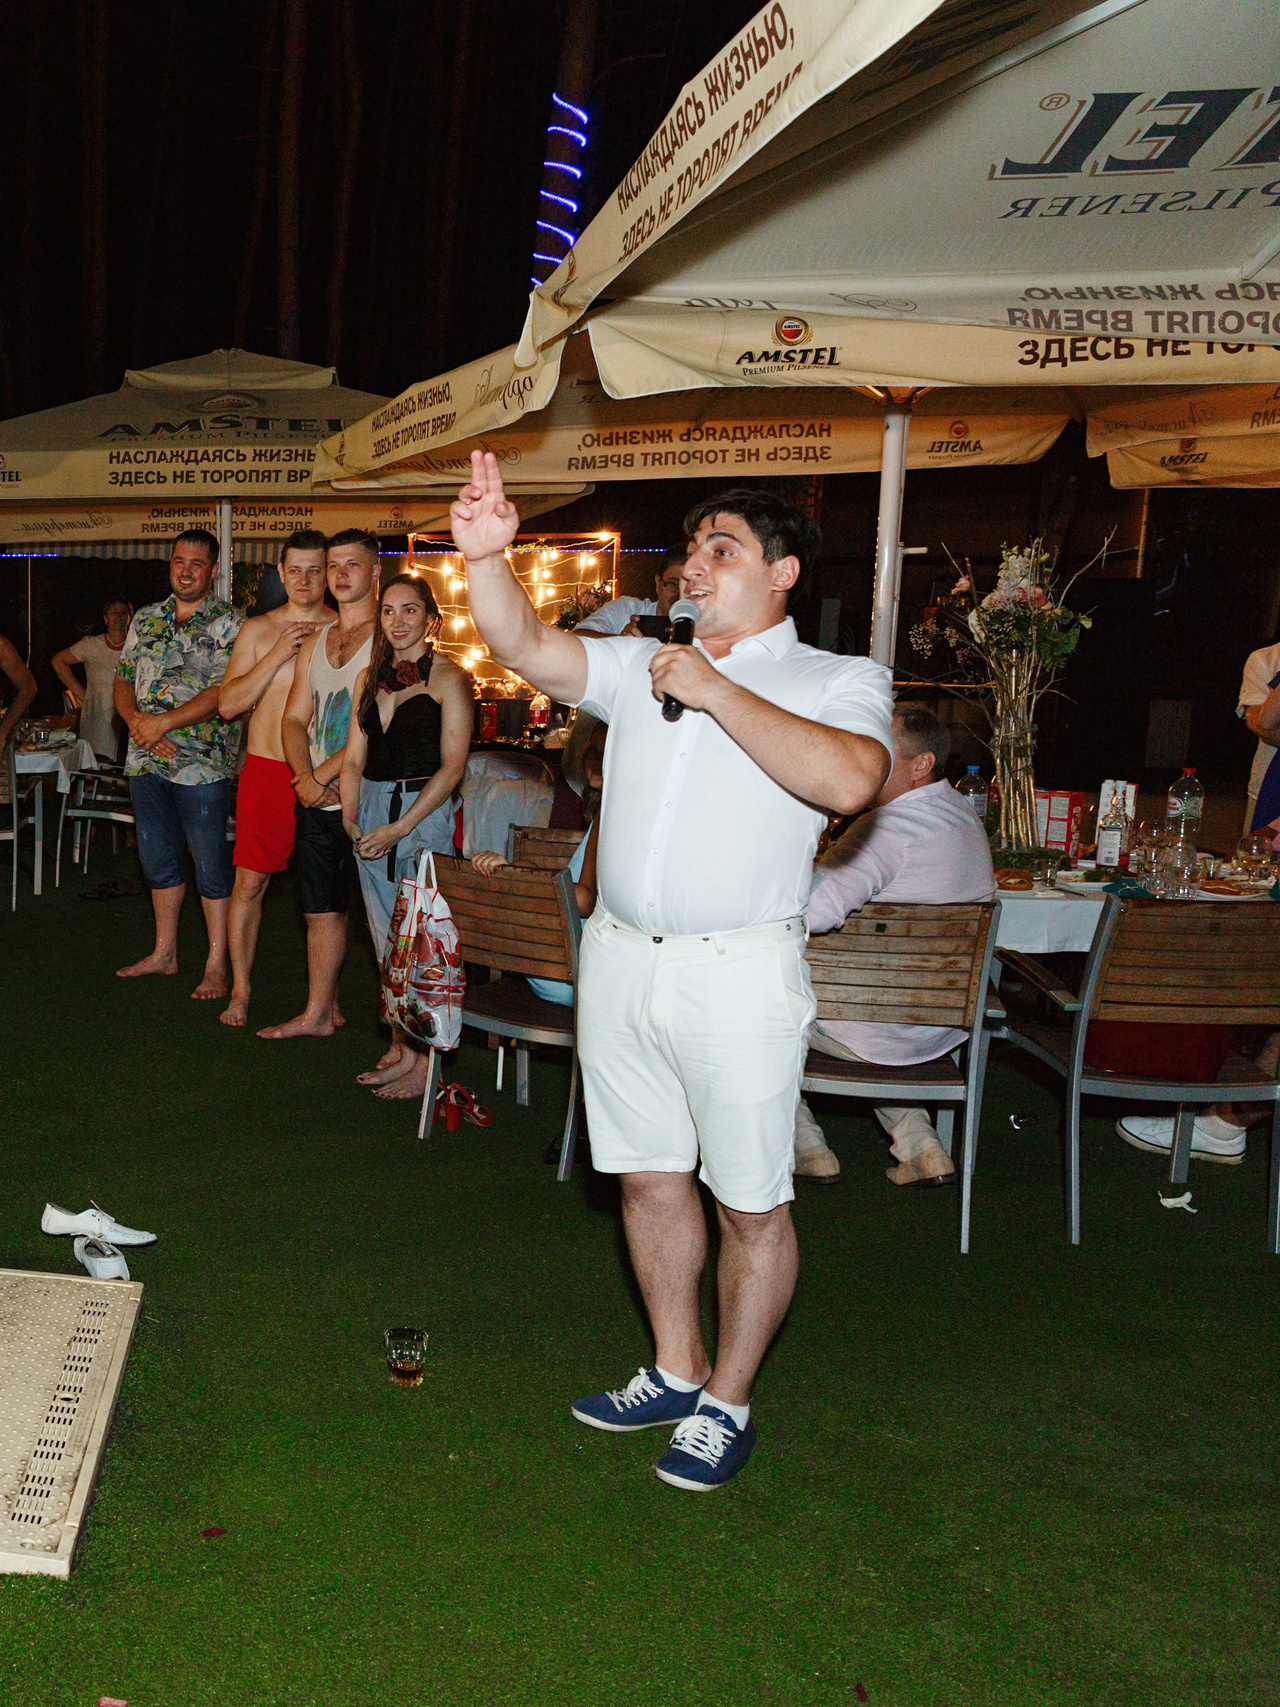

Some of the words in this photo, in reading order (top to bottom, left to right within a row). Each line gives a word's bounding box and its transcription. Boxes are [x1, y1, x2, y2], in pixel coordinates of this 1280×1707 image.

[617, 91, 706, 215] НАСЛАЖДАЯСЬ
[703, 2, 795, 116] ЖИЗНЬЮ,
[618, 205, 655, 263] ЗДЕСЬ
[656, 184, 674, 229] НЕ
[675, 120, 740, 211] ТОРОПЯТ
[735, 346, 841, 366] AMSTEL
[1018, 336, 1135, 369] ЗДЕСЬ
[742, 364, 784, 377] PREMIUM
[417, 381, 453, 411] ЖИЗНЬЮ,
[109, 449, 247, 466] НАСЛАЖДАЯСЬ
[251, 448, 316, 464] ЖИЗНЬ
[108, 470, 168, 487] ЗДЕСЬ
[172, 470, 196, 484] НЕ
[200, 470, 282, 484] ТОРОПЯТ
